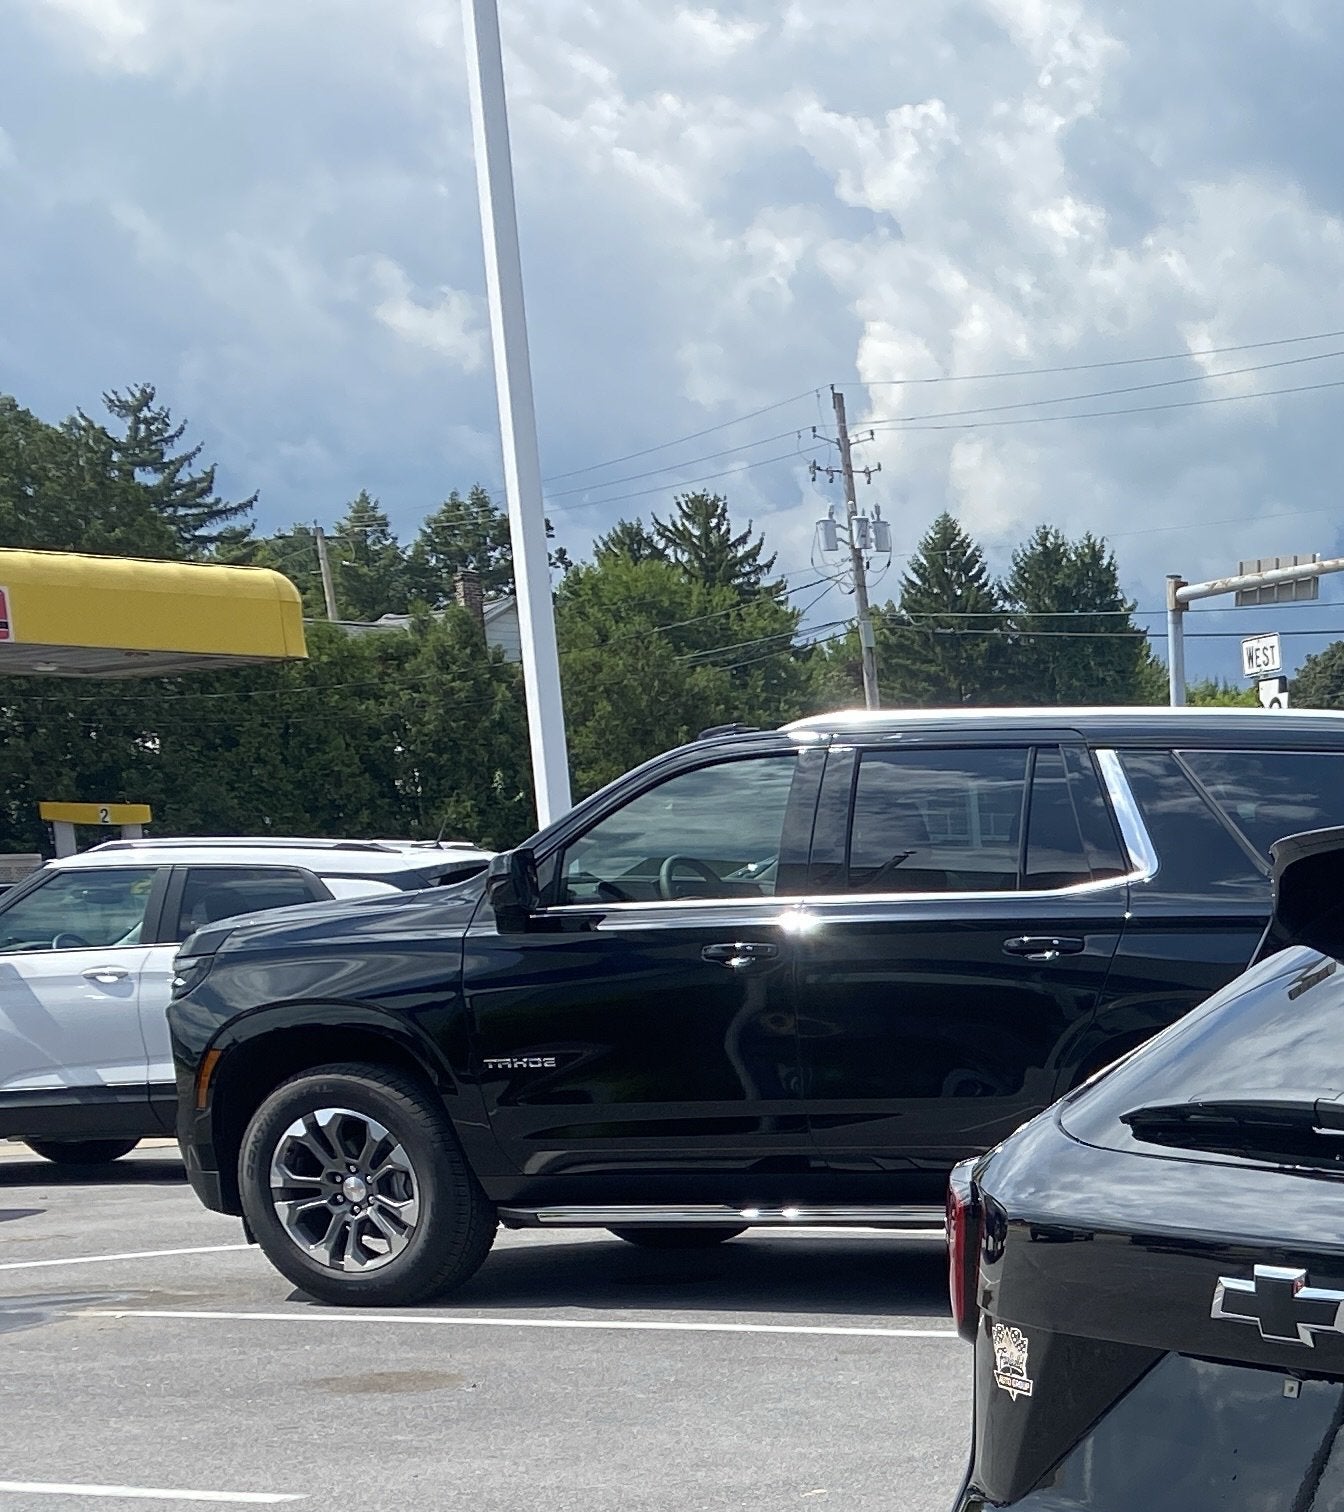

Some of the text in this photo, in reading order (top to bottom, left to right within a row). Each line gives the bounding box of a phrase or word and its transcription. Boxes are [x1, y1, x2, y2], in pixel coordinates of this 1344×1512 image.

[1245, 645, 1276, 669] WEST
[100, 808, 109, 823] 2
[483, 1057, 556, 1069] TAHOE
